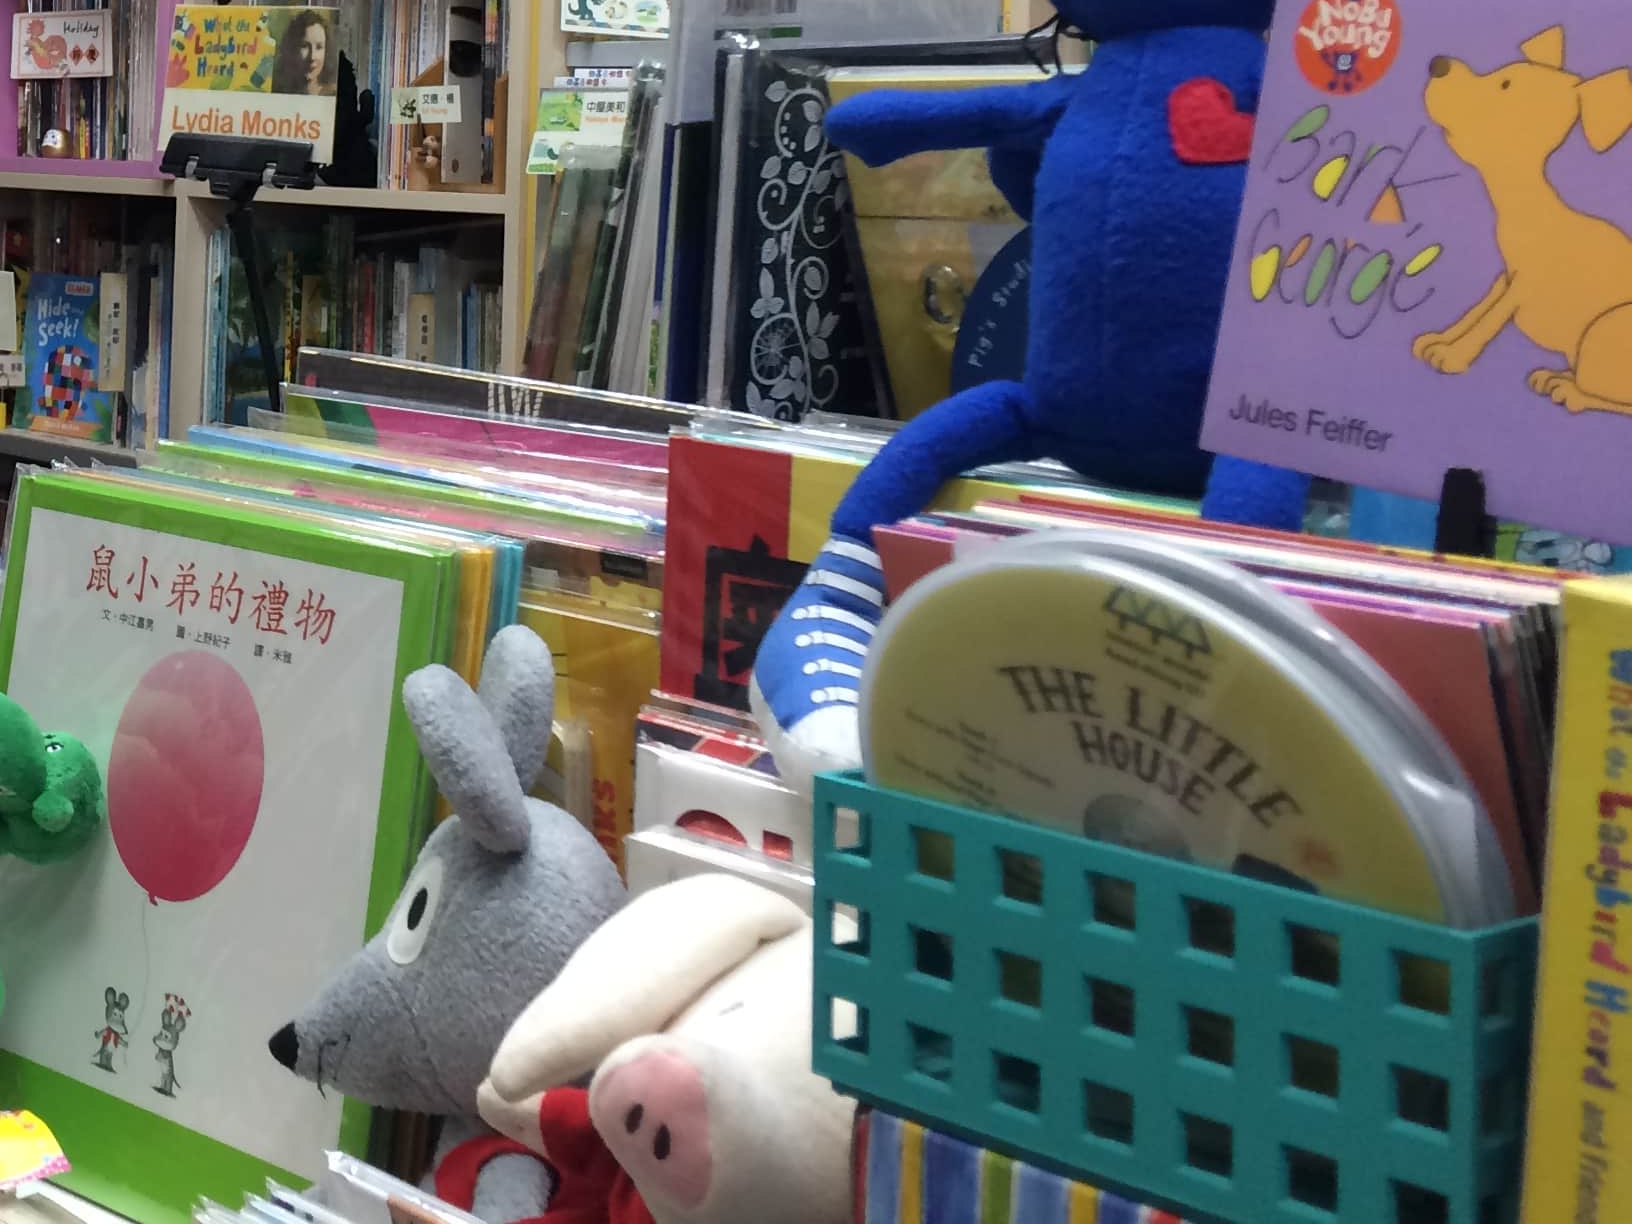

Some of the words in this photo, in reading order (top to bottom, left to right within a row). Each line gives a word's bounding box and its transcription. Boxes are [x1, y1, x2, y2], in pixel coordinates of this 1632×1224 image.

[63, 20, 100, 39] Holiday
[1298, 16, 1393, 58] Young
[171, 104, 234, 134] Lydia
[241, 109, 321, 140] Monks
[1249, 208, 1444, 340] George
[37, 297, 71, 321] Hide
[37, 318, 80, 347] Seek!
[1228, 392, 1299, 434] Jules
[1305, 409, 1394, 454] Feiffer
[85, 543, 337, 645] 鼠小弟的禮物
[998, 661, 1103, 718] THE
[1125, 686, 1305, 829] LITTLE
[1070, 718, 1226, 816] HOUSE
[1583, 979, 1632, 1092] Heard
